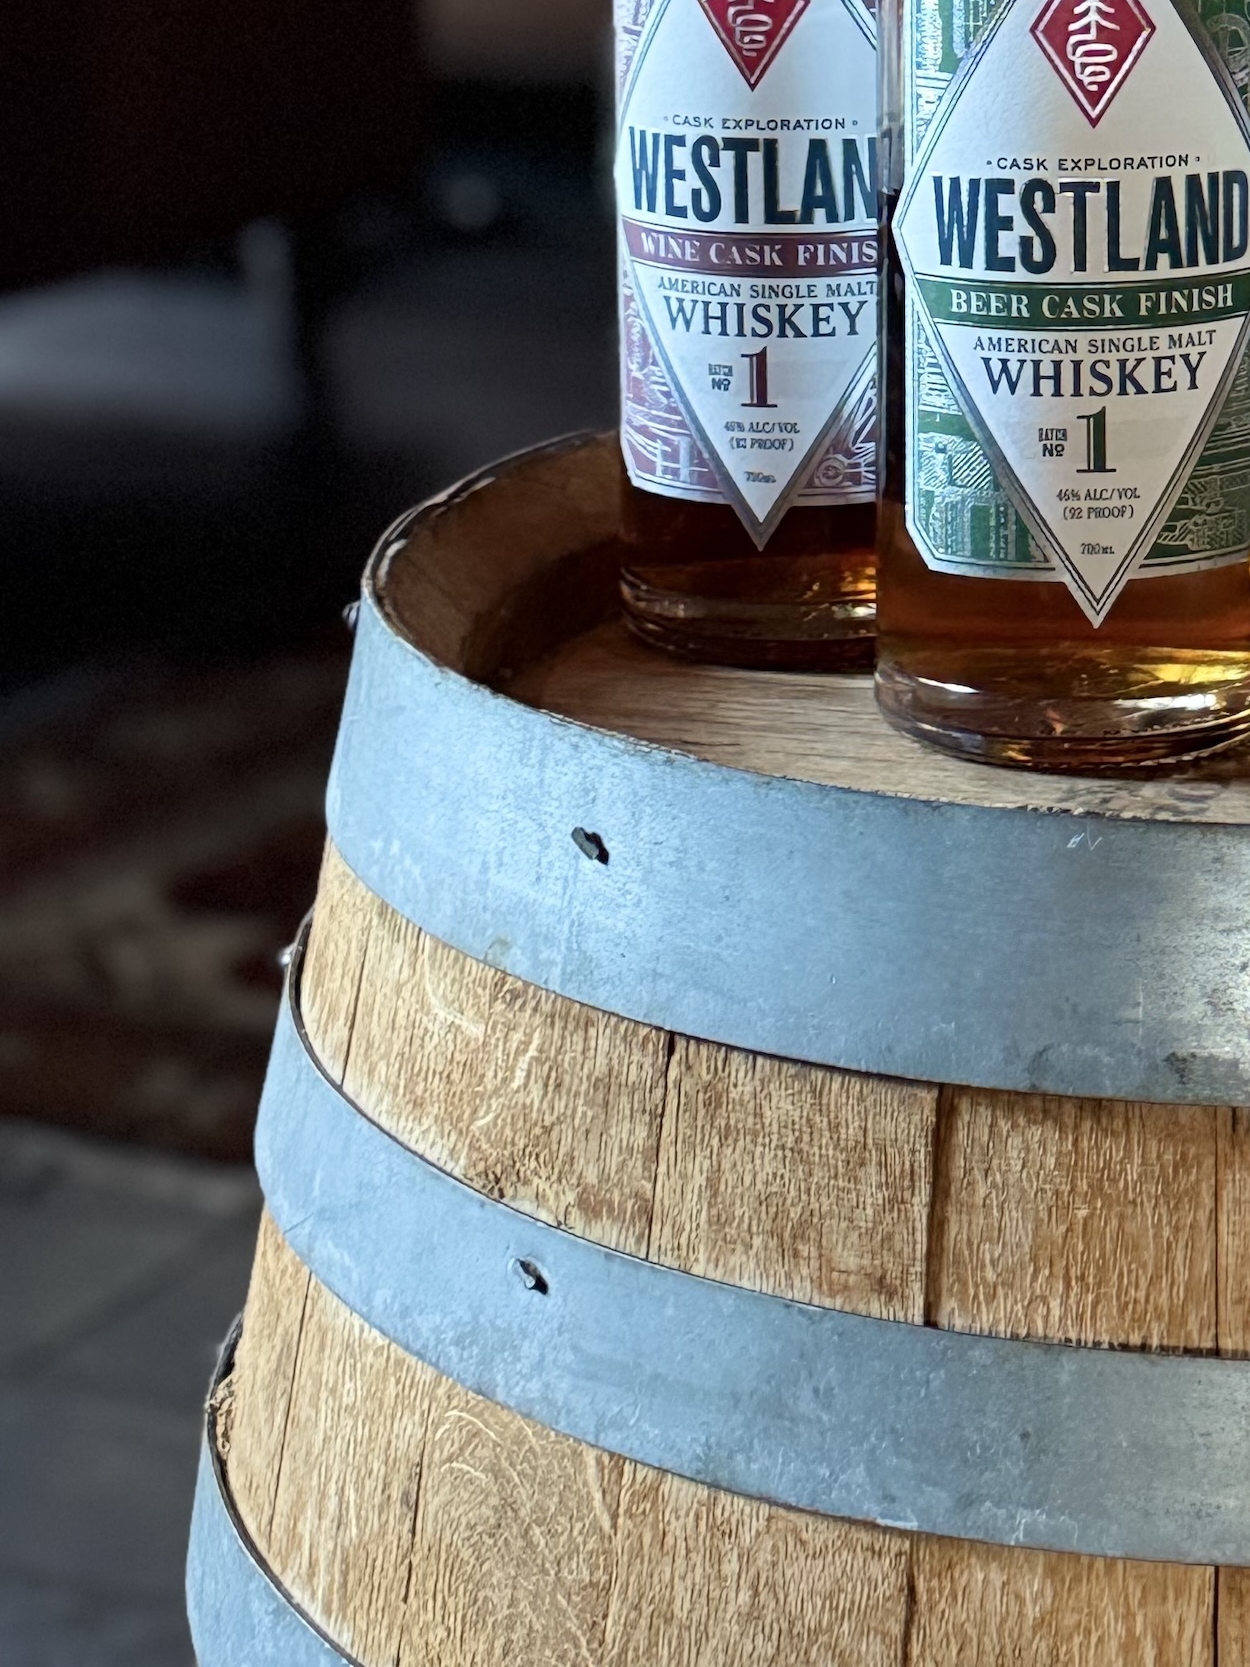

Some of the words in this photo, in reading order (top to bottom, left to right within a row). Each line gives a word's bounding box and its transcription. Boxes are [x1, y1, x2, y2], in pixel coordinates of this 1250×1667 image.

[673, 115, 714, 129] CASK
[722, 118, 846, 131] EXPLORATION
[997, 156, 1049, 171] CASK
[1058, 154, 1189, 172] EXPLORATION
[931, 170, 1249, 275] WESTLAND
[641, 232, 700, 262] WINE
[709, 242, 782, 267] CASK
[658, 277, 741, 298] AMERICAN
[750, 285, 817, 299] SINGLE
[826, 281, 876, 298] MALT
[950, 288, 1031, 317] BEER
[1041, 293, 1125, 320] CASK
[1138, 283, 1234, 314] FINISH
[663, 295, 868, 339] WHISKEY
[973, 335, 1078, 354] AMERICAN
[1088, 337, 1160, 354] SINGLE
[1168, 330, 1217, 349] MALT
[740, 346, 778, 408] 1
[979, 351, 1208, 398] WHISKEY
[1076, 405, 1117, 473] 1
[1084, 487, 1141, 501] ALC/VOL
